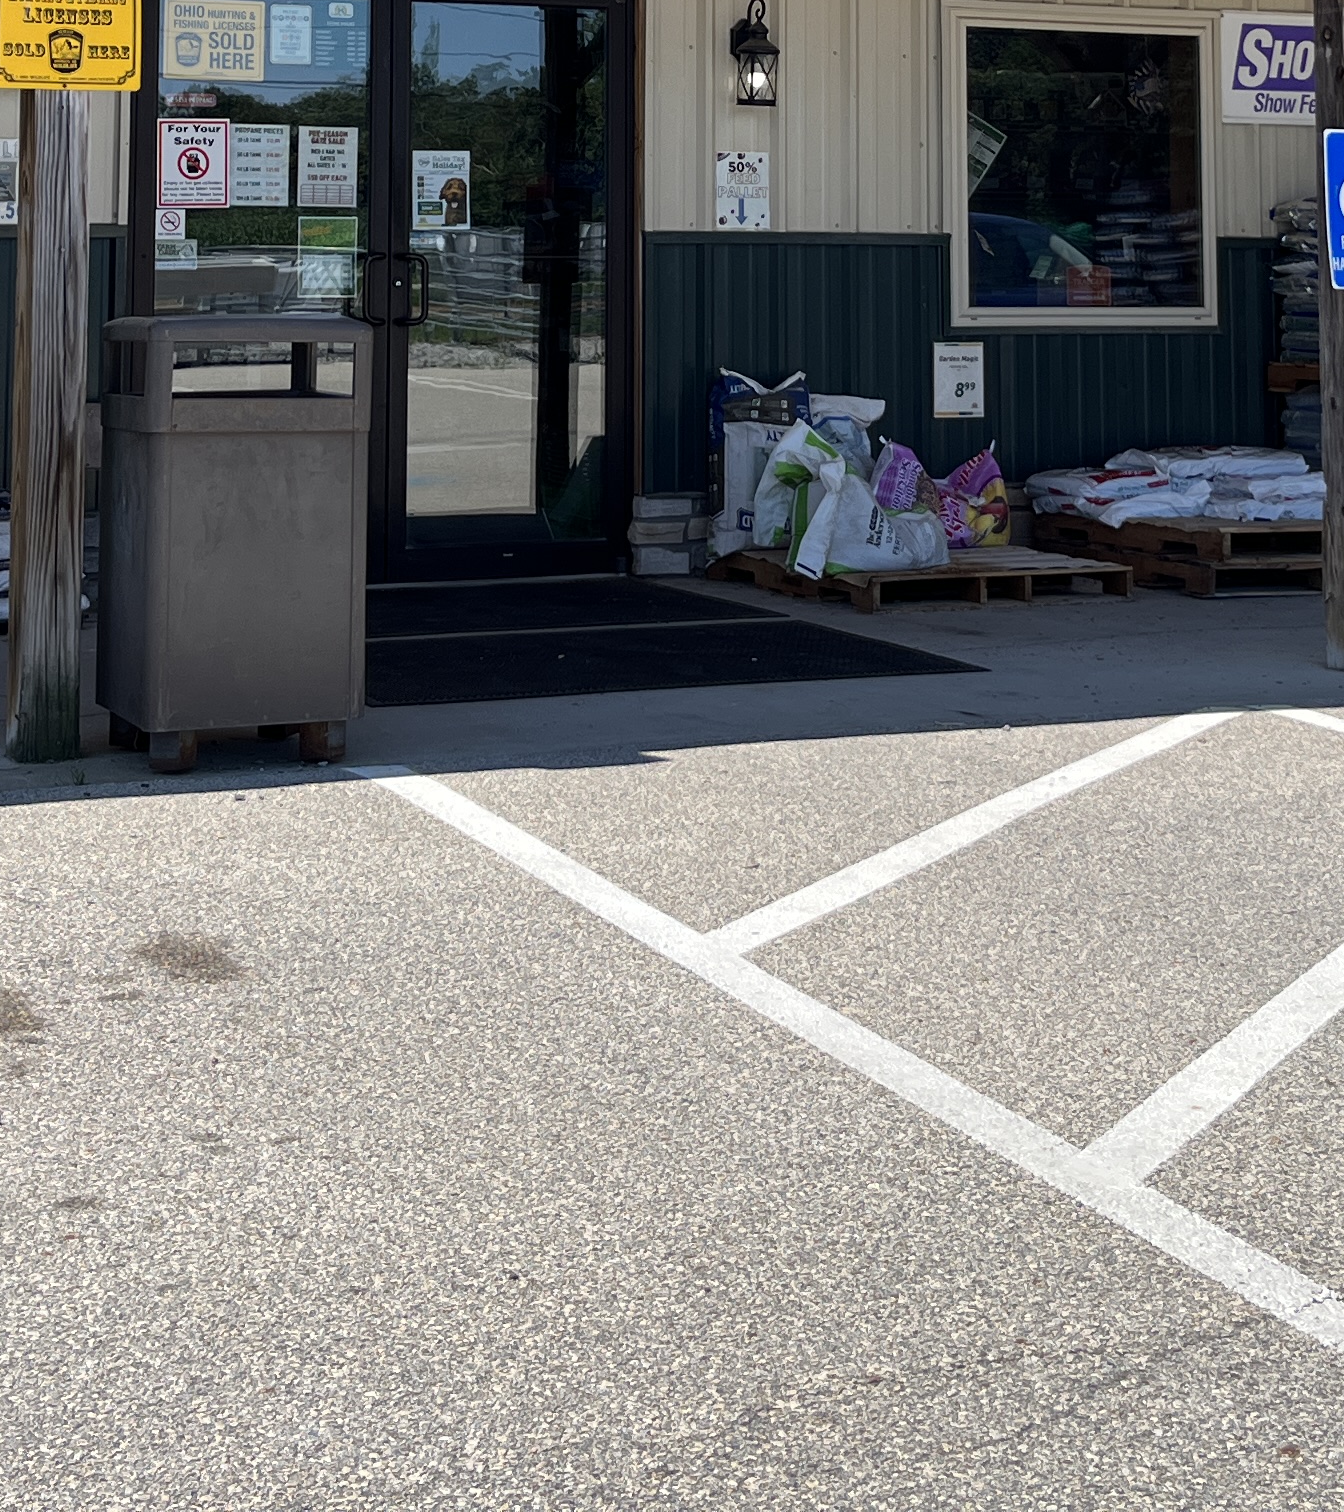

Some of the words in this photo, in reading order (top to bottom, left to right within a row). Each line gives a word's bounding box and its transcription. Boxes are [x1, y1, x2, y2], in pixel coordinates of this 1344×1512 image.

[22, 6, 113, 26] LICENSES
[173, 4, 205, 19] OHIO
[207, 9, 247, 20] HUNTING
[249, 11, 256, 21] &
[173, 19, 209, 30] FISHING
[212, 20, 256, 32] LICENSES
[208, 31, 255, 51] SOLD
[2, 42, 46, 58] SOLD
[87, 44, 130, 60] HERE
[208, 51, 255, 71] HERE
[1253, 91, 1297, 114] Show
[167, 124, 189, 133] For
[193, 124, 221, 133] Your
[173, 136, 215, 147] Safety
[728, 161, 758, 174] 50%
[726, 172, 761, 185] FEED
[717, 185, 769, 199] PALLET
